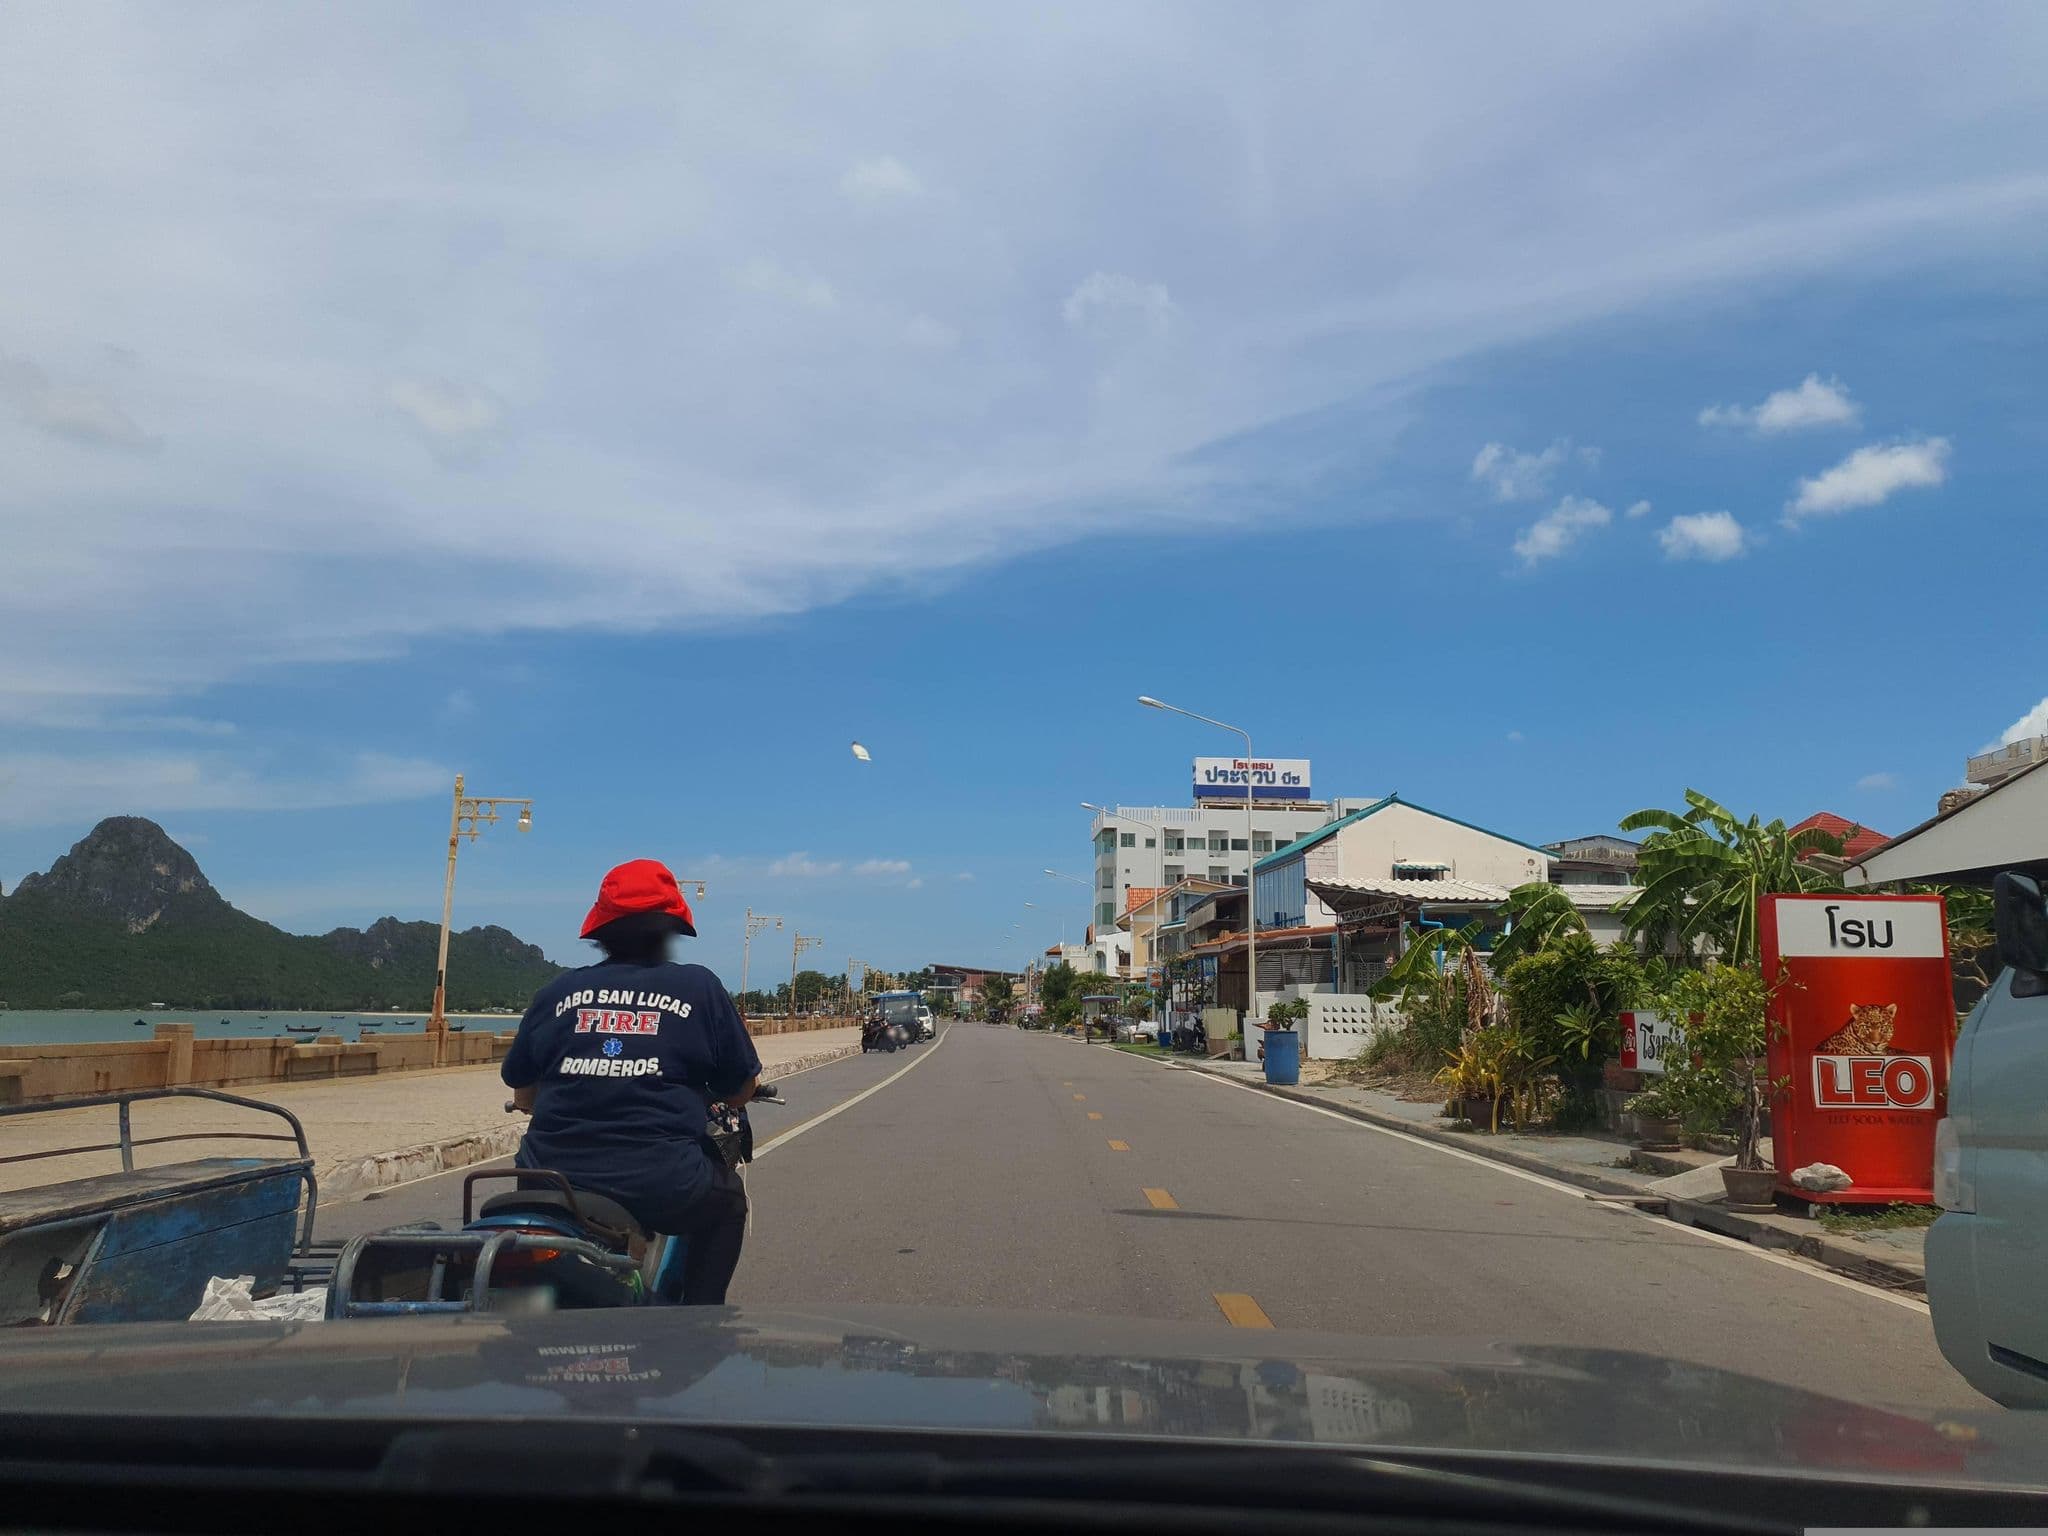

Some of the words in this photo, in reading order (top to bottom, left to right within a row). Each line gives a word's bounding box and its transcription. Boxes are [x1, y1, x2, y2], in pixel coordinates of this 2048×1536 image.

[1824, 905, 1894, 949] โรม
[555, 989, 594, 1018] CABO
[597, 989, 635, 1006] SAN
[637, 991, 692, 1018] LUCAS
[574, 1008, 661, 1035] FIRE
[1817, 1057, 1932, 1108] LEO
